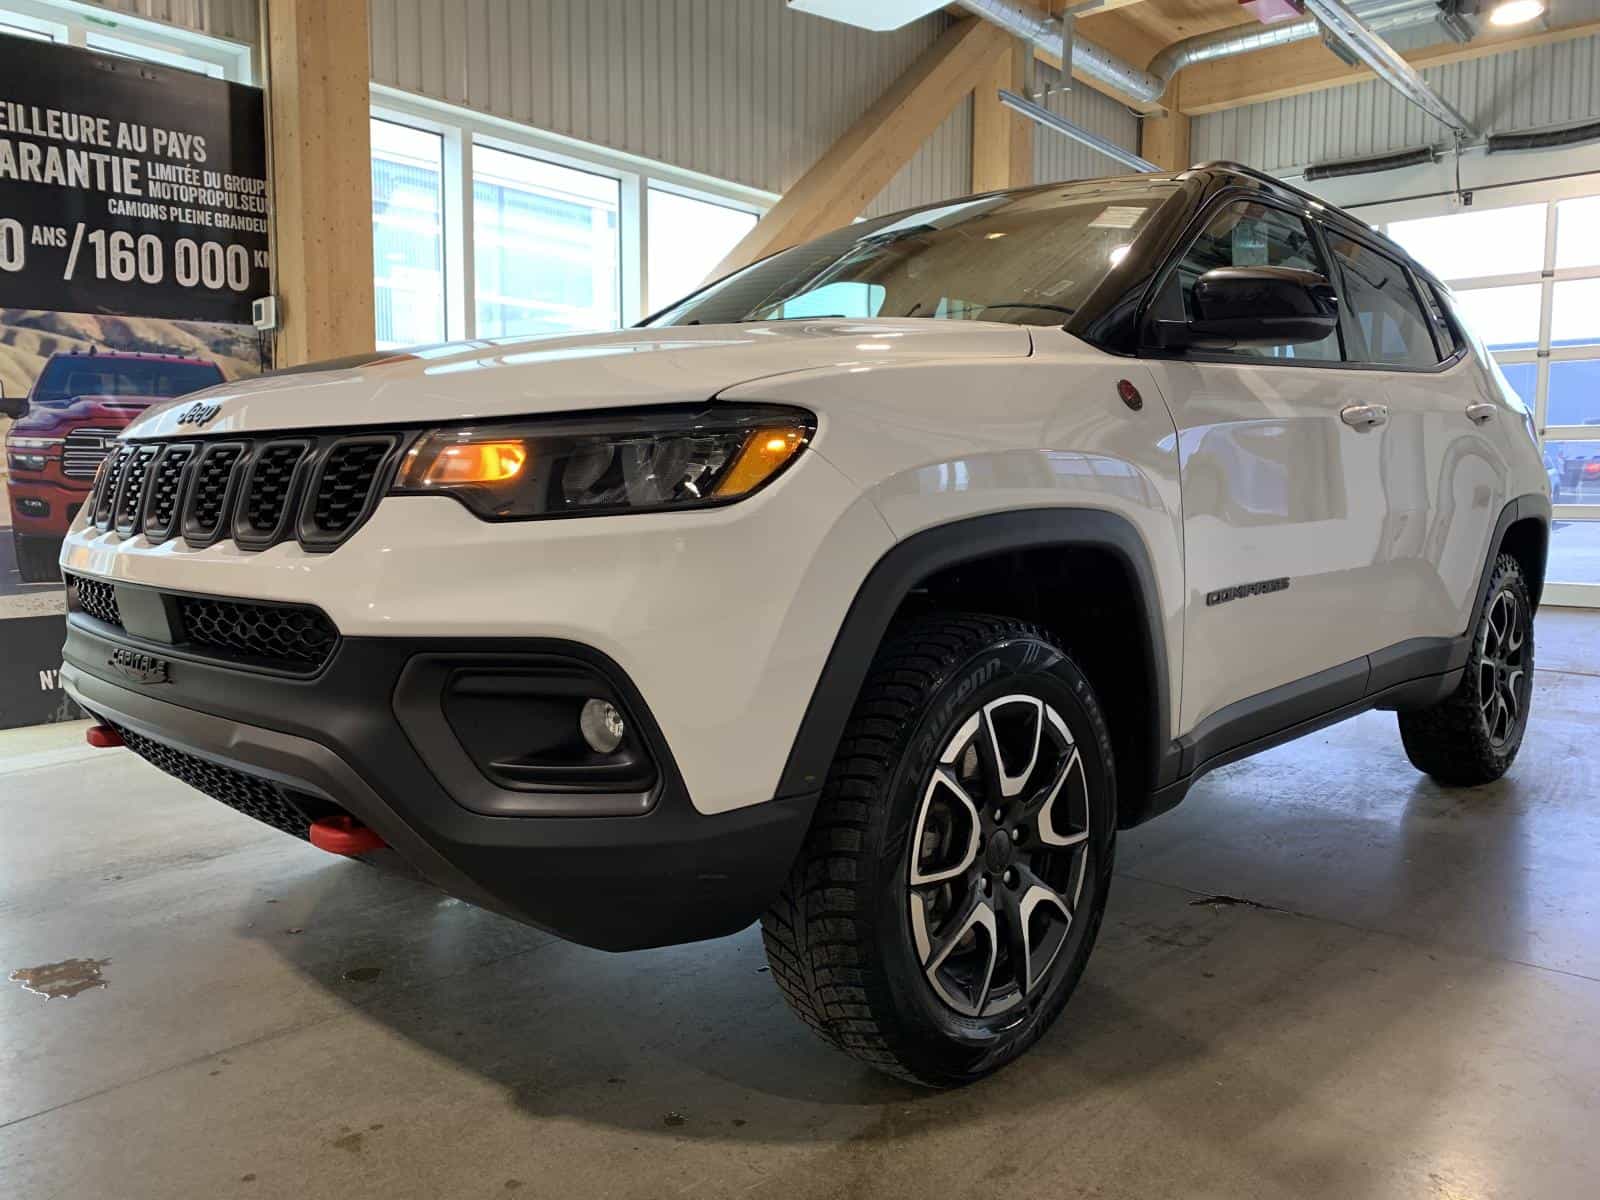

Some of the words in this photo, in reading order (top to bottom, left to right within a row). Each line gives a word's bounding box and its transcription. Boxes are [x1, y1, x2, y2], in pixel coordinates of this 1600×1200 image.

[117, 121, 147, 153] AU
[153, 127, 207, 163] PAYS
[147, 161, 201, 186] LIMITÉE
[203, 170, 221, 190] DU
[223, 174, 267, 195] GROUP
[148, 180, 267, 213] MOTOPROPULSEU
[108, 198, 168, 221] CAMIONS
[170, 206, 213, 227] PLEINE
[31, 225, 68, 248] ANS
[174, 238, 250, 292] 000
[177, 402, 221, 427] Jeep
[1206, 577, 1290, 607] COMPASS
[112, 648, 169, 674] CAPITALE
